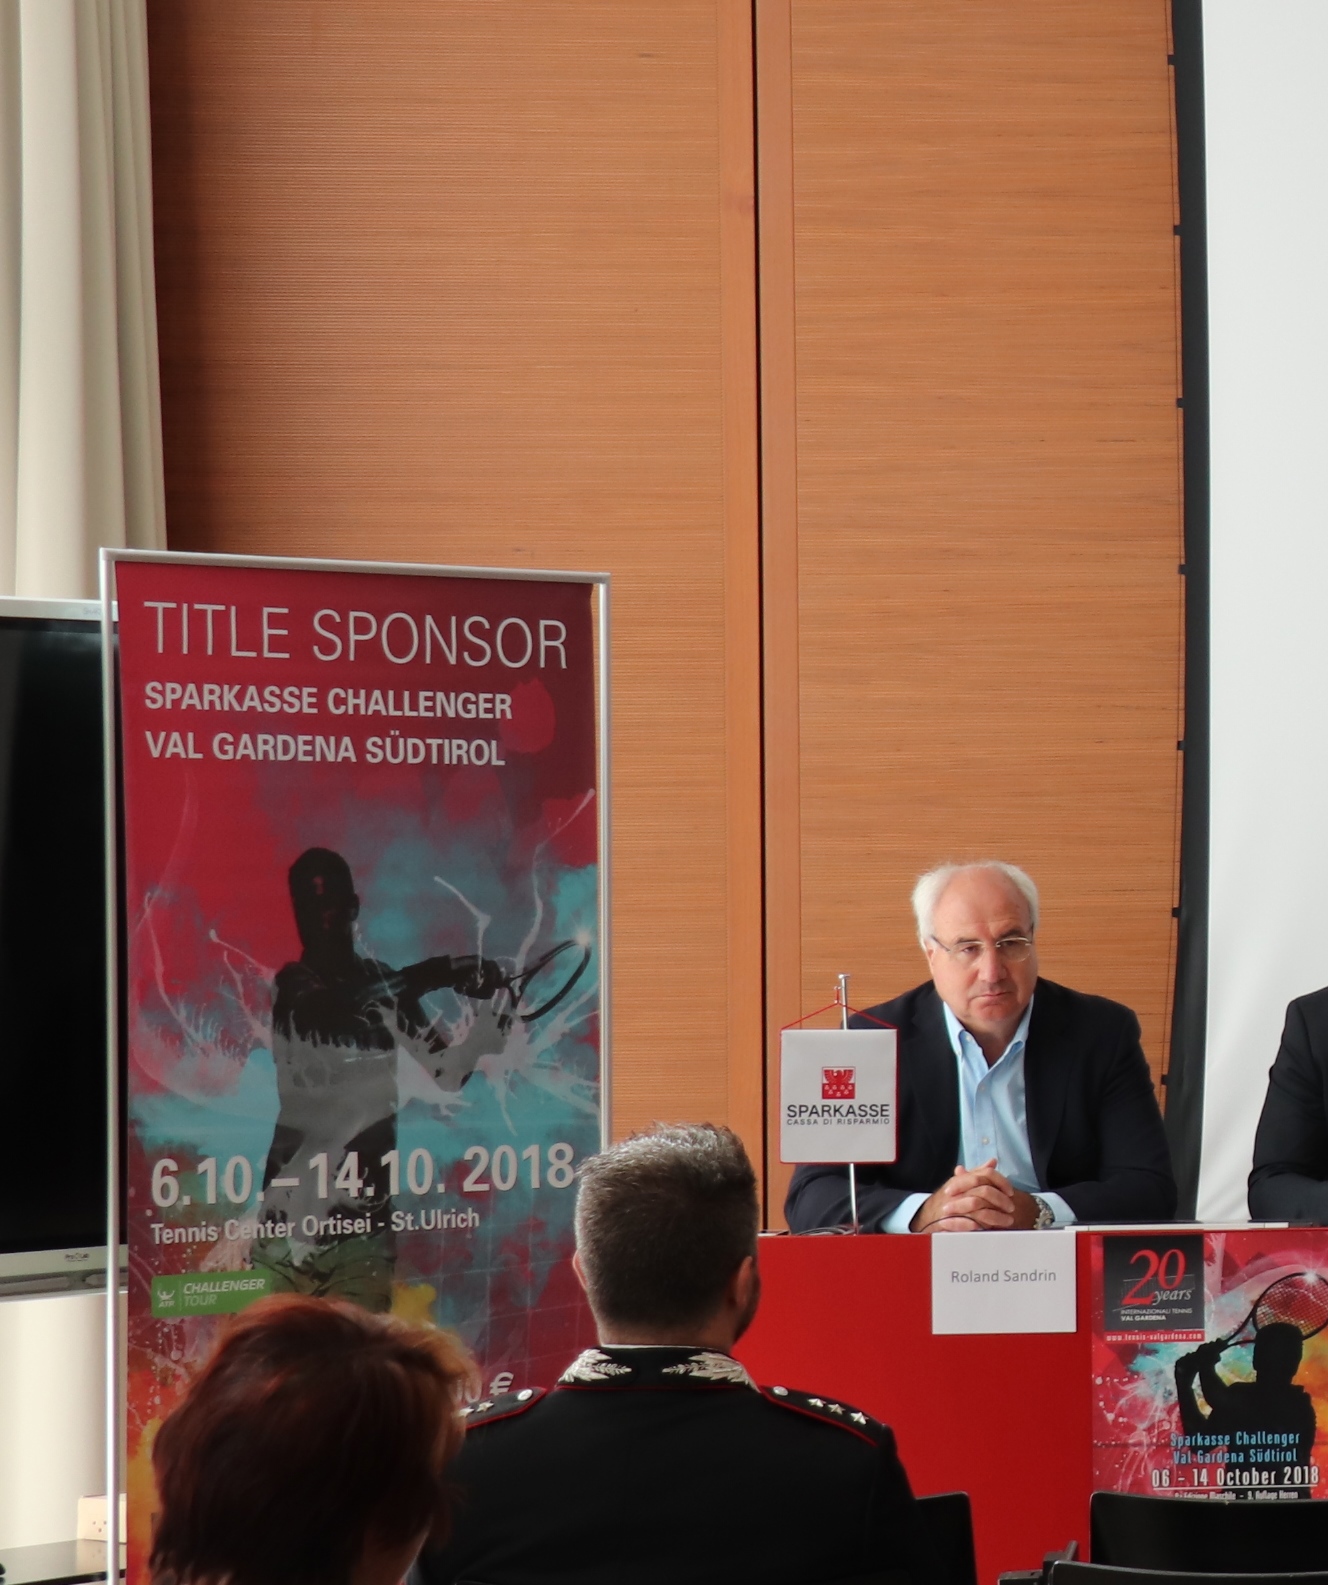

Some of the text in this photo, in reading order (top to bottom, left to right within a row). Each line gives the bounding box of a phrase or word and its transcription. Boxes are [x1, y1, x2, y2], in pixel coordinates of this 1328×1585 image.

[144, 601, 567, 669] TITLE SPONSOR
[145, 682, 512, 720] SPARKASSE CHALLENGER
[145, 731, 505, 766] VAL GARDENA SÜDTIROL
[787, 1104, 890, 1118] SPARKASSE
[787, 1118, 818, 1126] CASSA
[463, 1143, 575, 1192] 2018
[151, 1222, 219, 1245] Tennis
[224, 1218, 295, 1241] Center
[302, 1213, 371, 1237] Ortisei
[951, 1268, 1057, 1283] Roland Sandrin
[1122, 1248, 1186, 1306] 20
[183, 1279, 265, 1294] CHALLENGER
[158, 1300, 175, 1308] ATP
[184, 1294, 217, 1306] TOUR
[1152, 1289, 1193, 1306] years
[1170, 1431, 1300, 1448] Sparkasse Challenger
[1173, 1448, 1297, 1464] Val Gardena Südtirol
[1152, 1469, 1170, 1487] 06
[1193, 1468, 1208, 1486] 14
[1217, 1467, 1276, 1485] October
[1283, 1466, 1319, 1484] 2018
